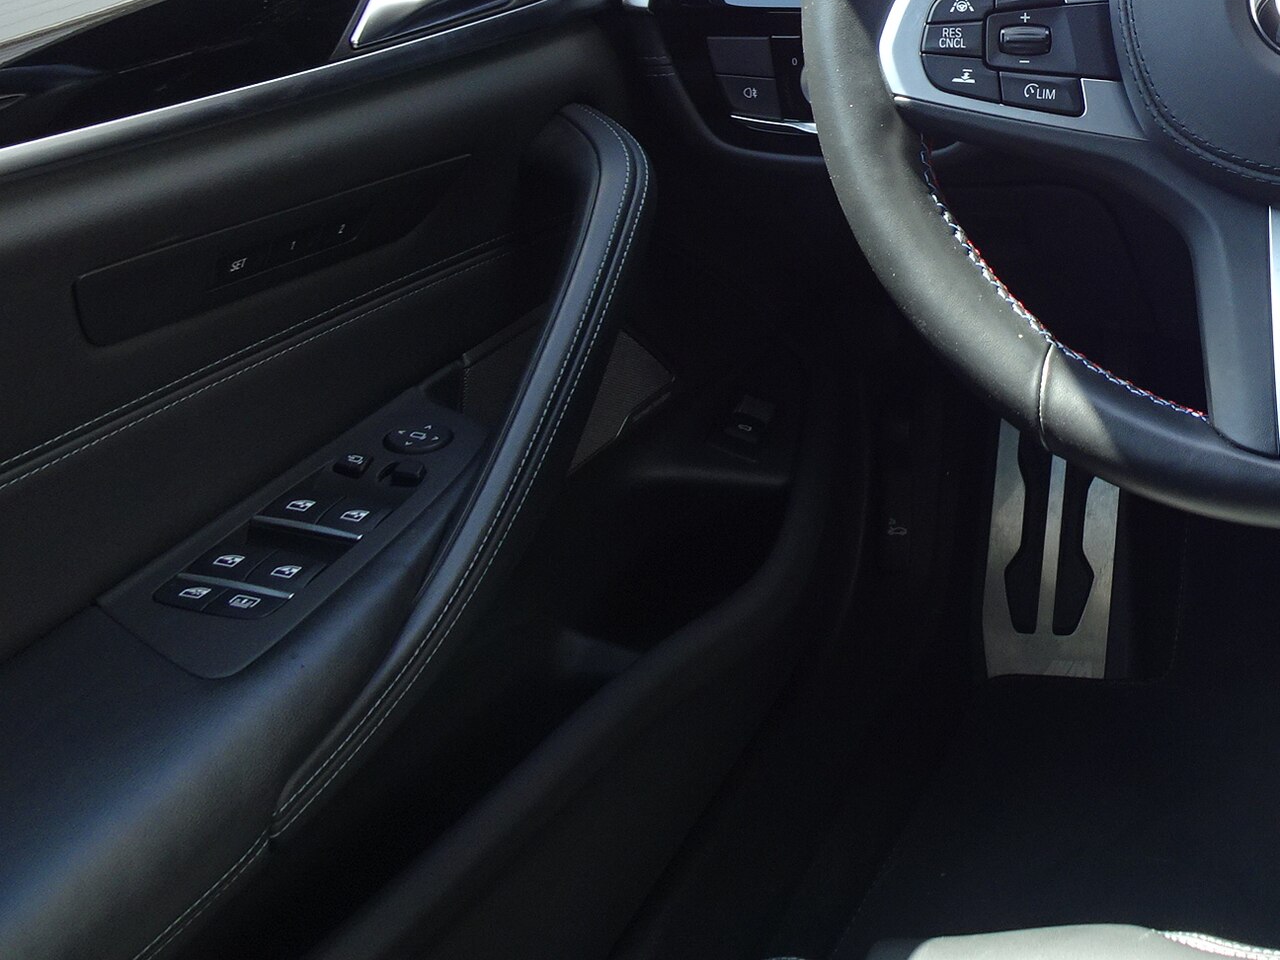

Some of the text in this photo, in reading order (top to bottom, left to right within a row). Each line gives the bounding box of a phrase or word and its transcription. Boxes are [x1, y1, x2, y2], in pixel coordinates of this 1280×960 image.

[942, 27, 962, 38] RES
[938, 37, 967, 49] CNCL
[1035, 88, 1056, 100] LIM
[229, 257, 248, 273] SET
